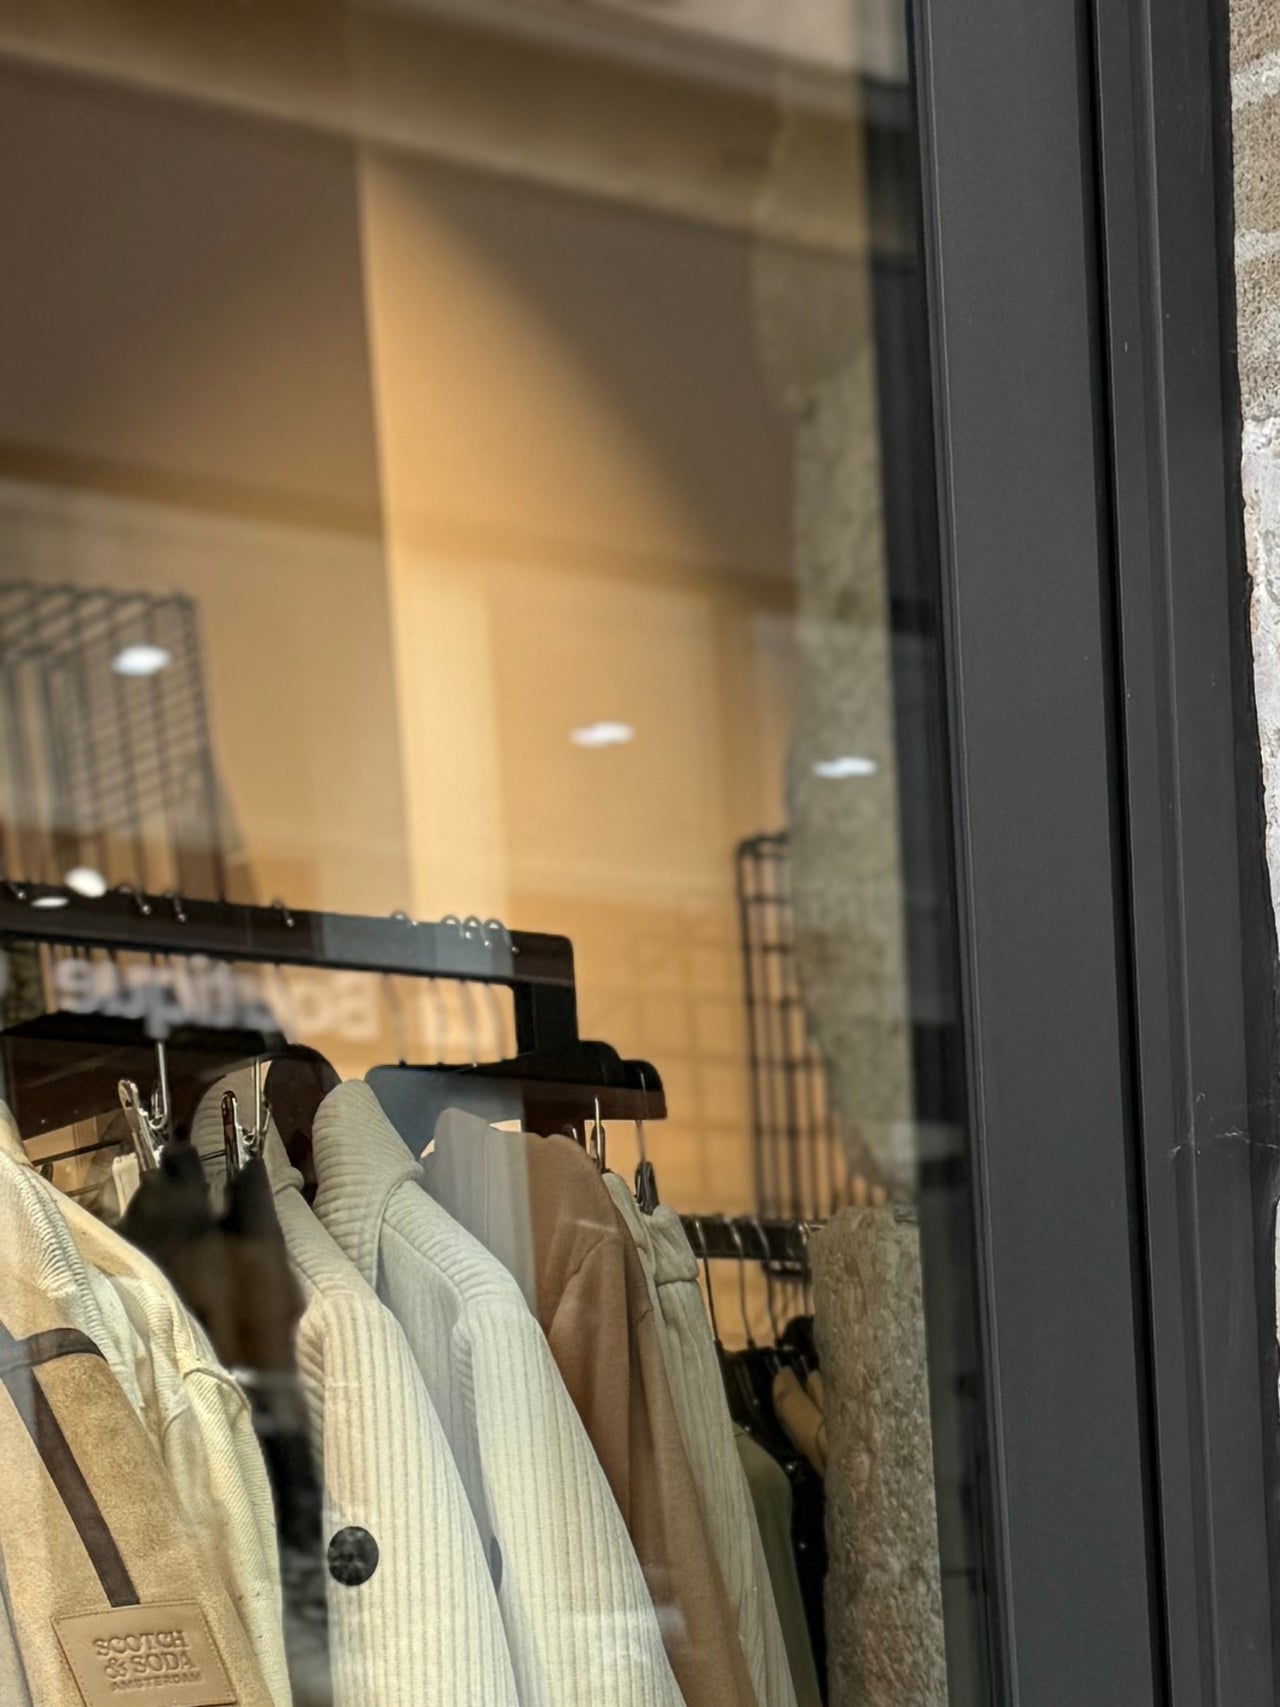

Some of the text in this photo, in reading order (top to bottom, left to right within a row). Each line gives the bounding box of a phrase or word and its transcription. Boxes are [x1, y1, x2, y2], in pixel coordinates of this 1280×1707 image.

[92, 1630, 188, 1657] SCOTCH
[104, 1651, 197, 1680] & SODA
[111, 1671, 202, 1691] AMSTERDAM
